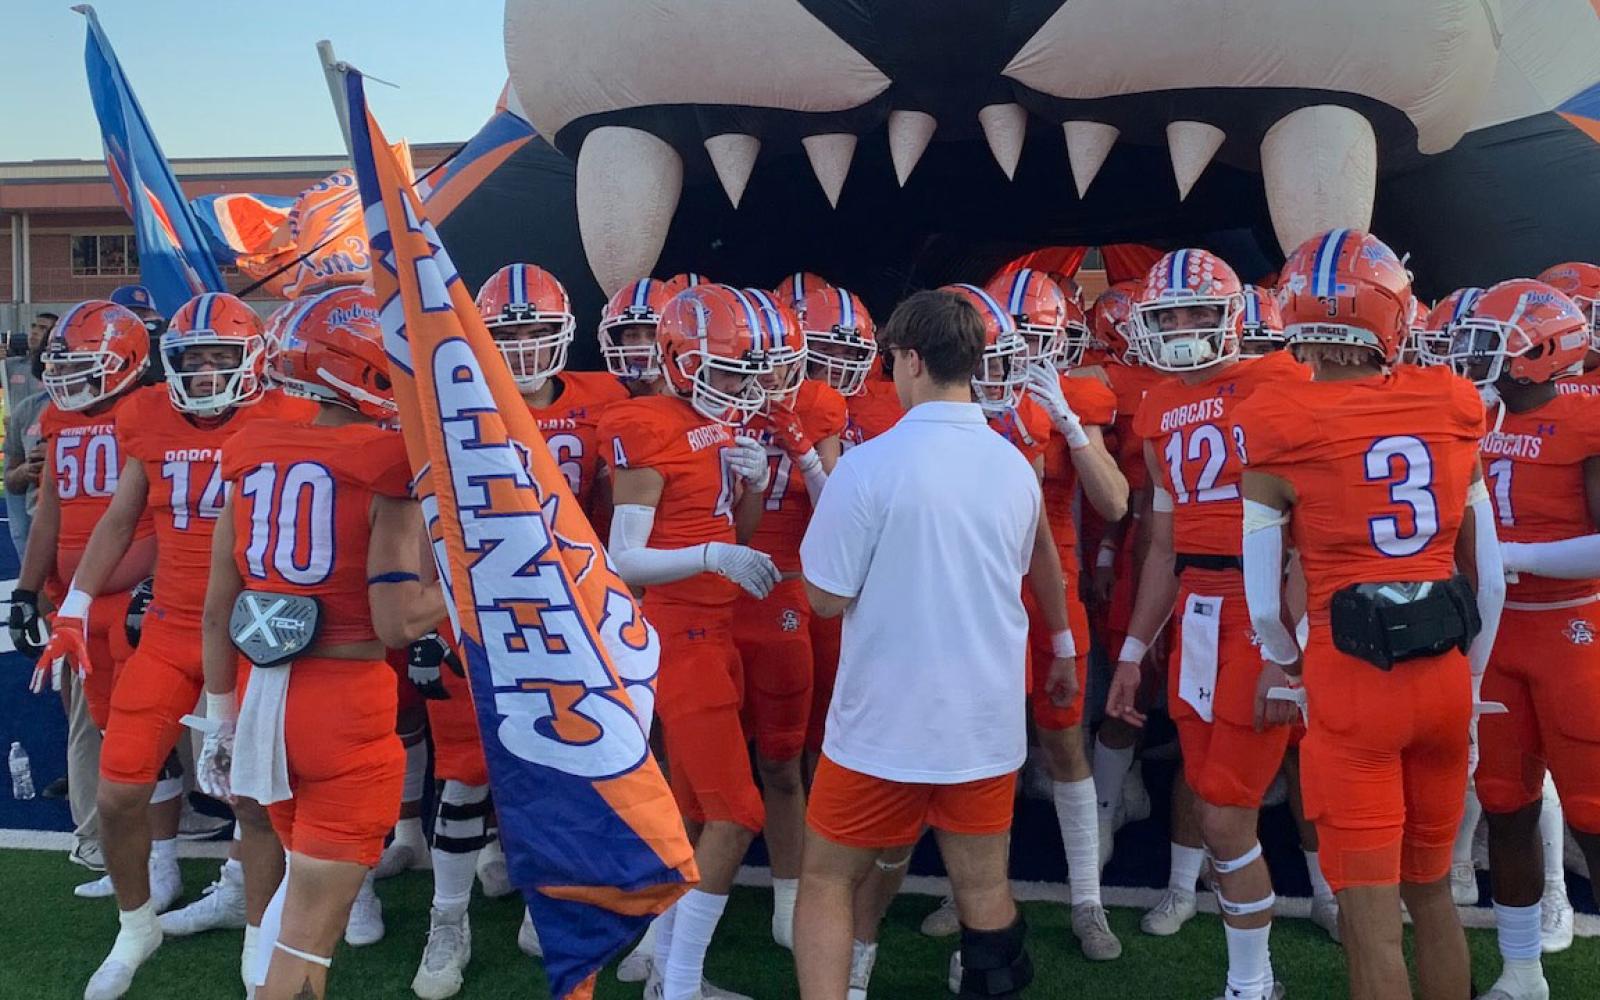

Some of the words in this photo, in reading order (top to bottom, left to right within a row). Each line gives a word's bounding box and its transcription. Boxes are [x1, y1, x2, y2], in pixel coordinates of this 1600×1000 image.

[1160, 398, 1223, 432] BOBCATS
[56, 433, 119, 500] 50
[161, 460, 233, 530] 14
[1163, 423, 1241, 505] 12
[1364, 434, 1439, 558] 3
[1487, 457, 1517, 528] 1
[241, 460, 337, 586] 10
